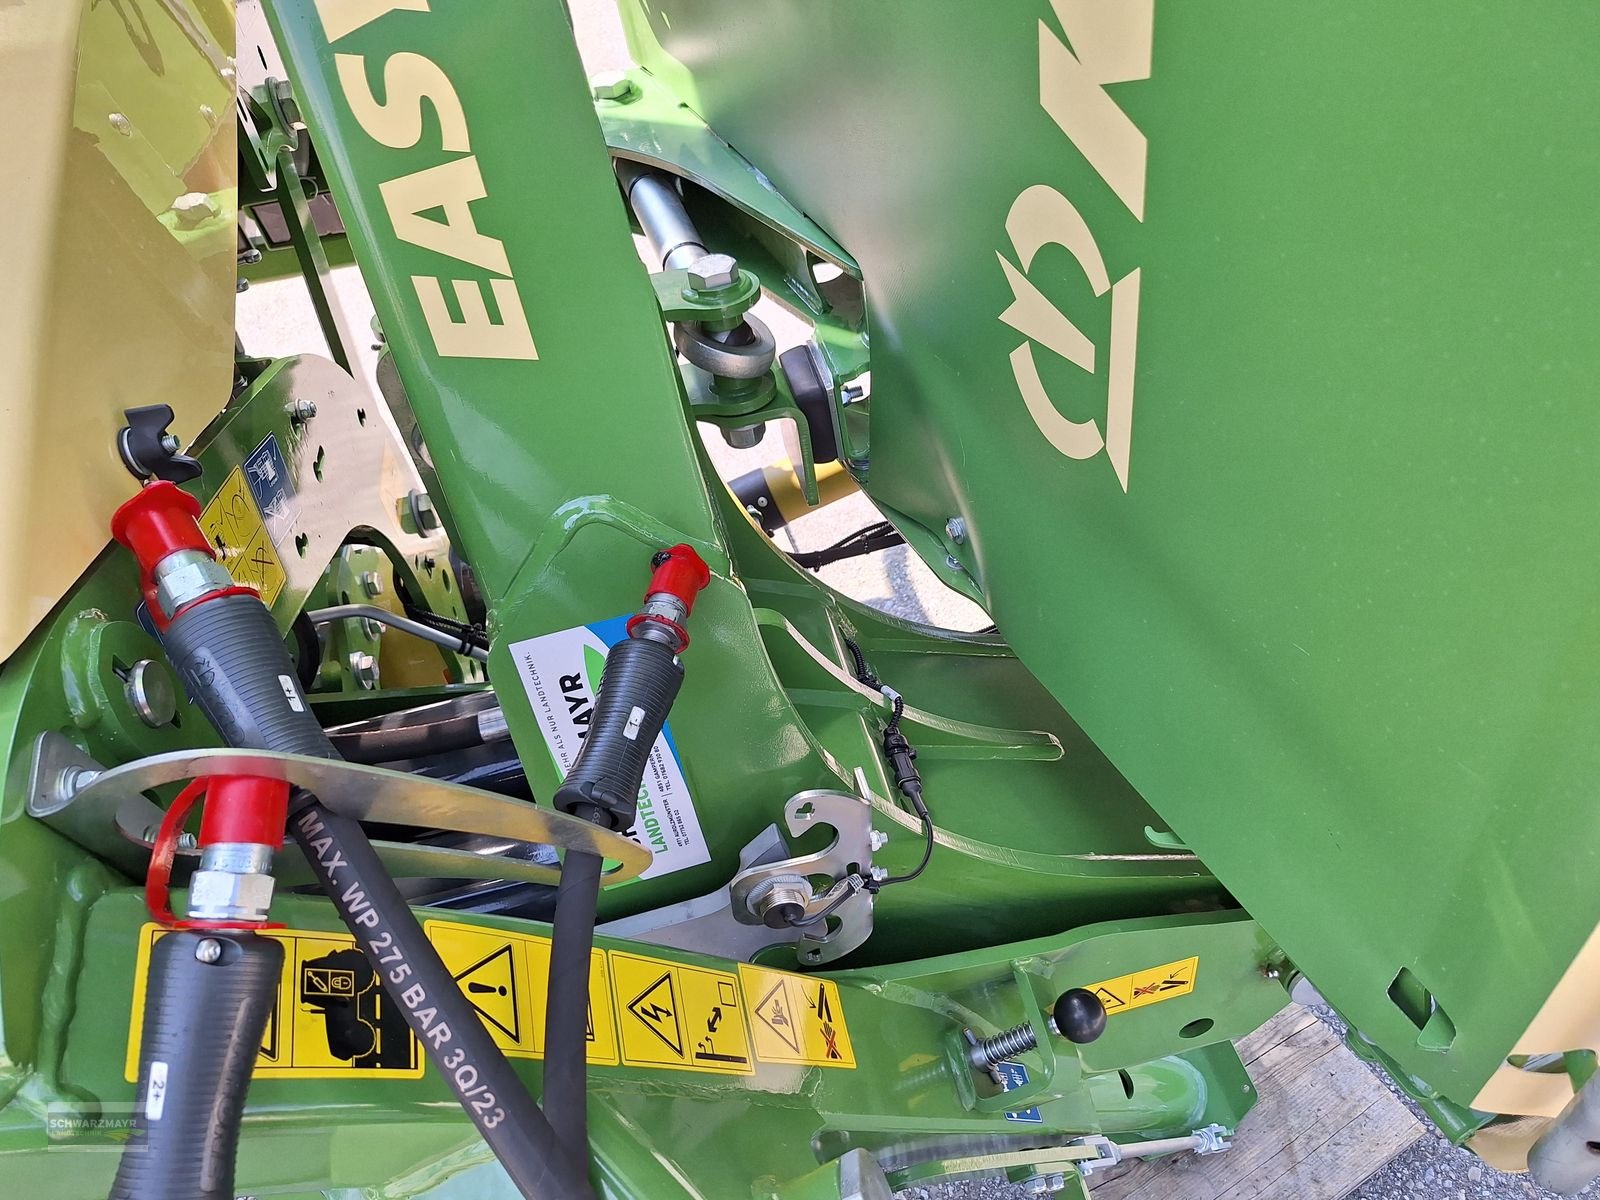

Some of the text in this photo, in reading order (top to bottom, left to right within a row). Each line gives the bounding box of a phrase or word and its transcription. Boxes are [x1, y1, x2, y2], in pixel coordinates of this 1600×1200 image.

[523, 651, 553, 713] LANDTECHNIK.
[546, 715, 558, 733] NUR
[554, 734, 565, 750] ALS
[656, 780, 664, 793] 4851
[298, 811, 350, 885] MAX.
[341, 881, 380, 930] WP
[370, 932, 413, 984] 275
[401, 982, 454, 1050] BAR
